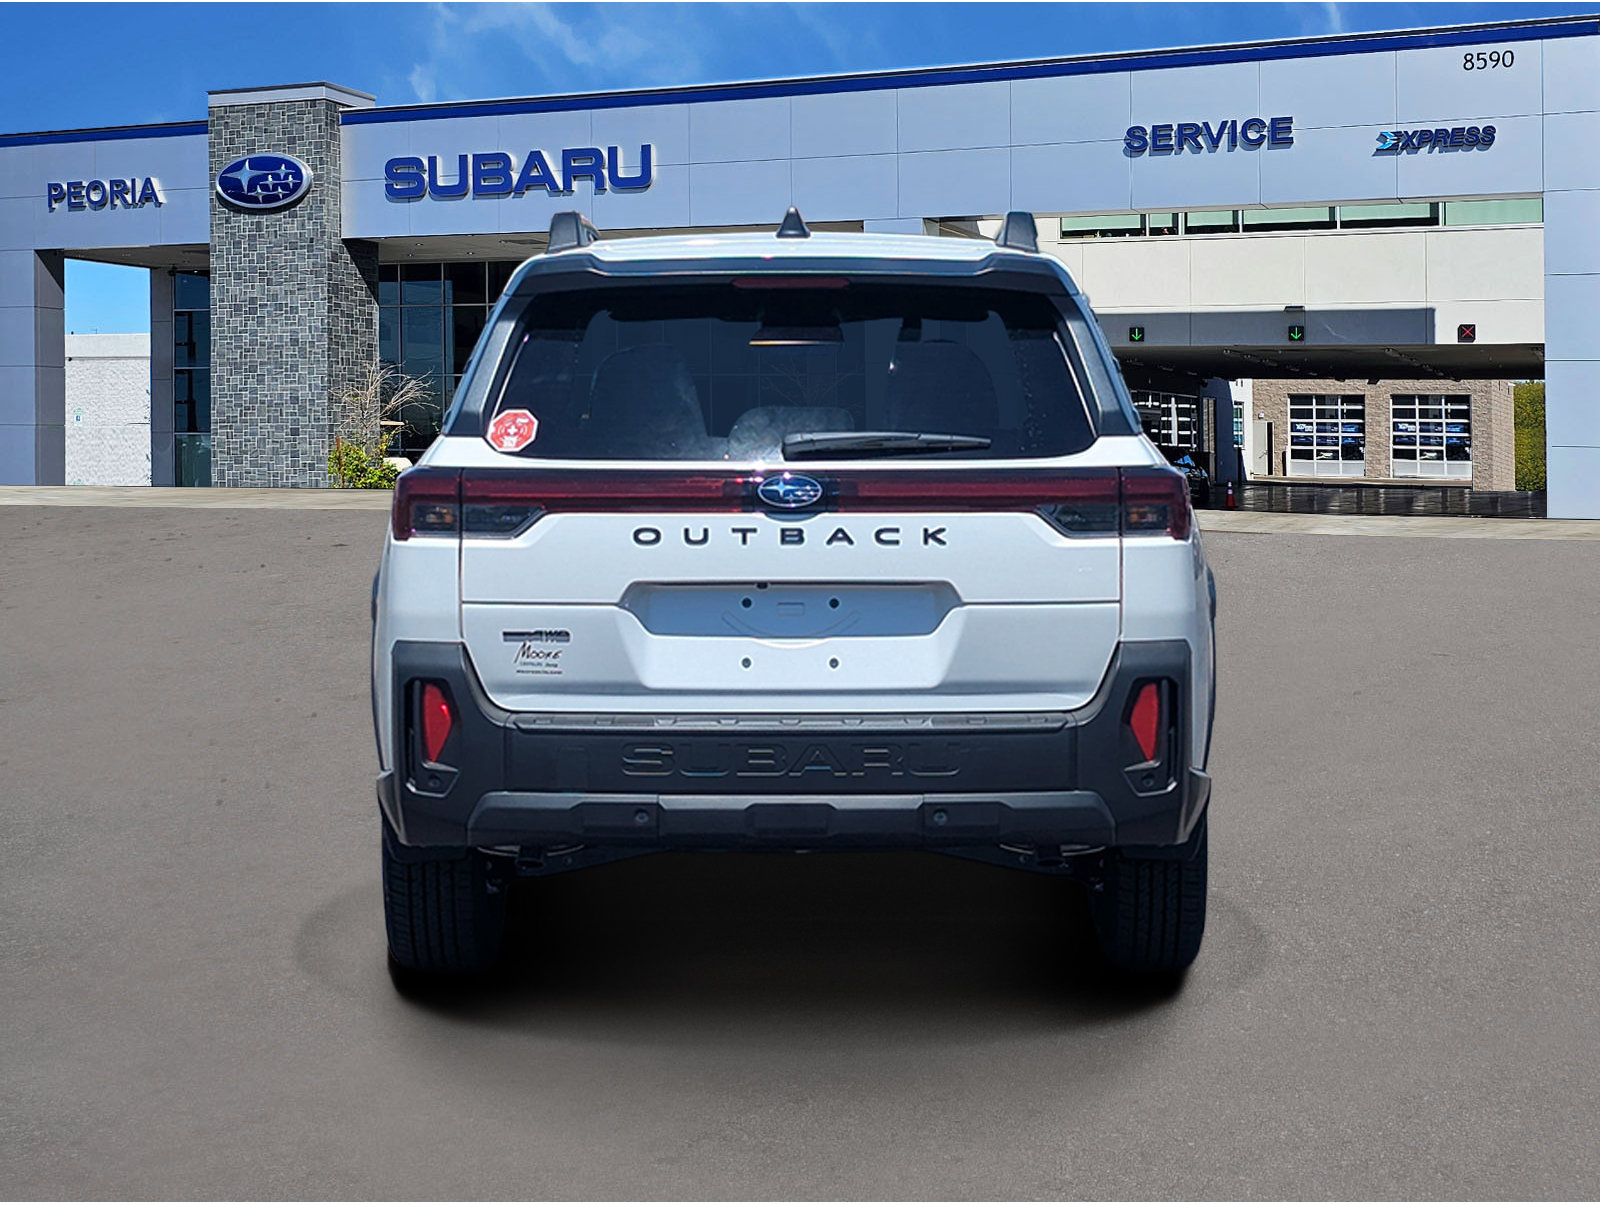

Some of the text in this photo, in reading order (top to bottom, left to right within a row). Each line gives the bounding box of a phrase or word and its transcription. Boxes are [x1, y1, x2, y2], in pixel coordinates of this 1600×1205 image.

[1463, 50, 1515, 71] 8590
[1124, 116, 1294, 154] SERVICE
[1375, 125, 1497, 153] EXPRESS
[384, 143, 654, 202] SUBARU
[47, 177, 163, 211] PEORIA
[632, 527, 948, 546] OUTBACK
[621, 743, 962, 777] SUBARU
